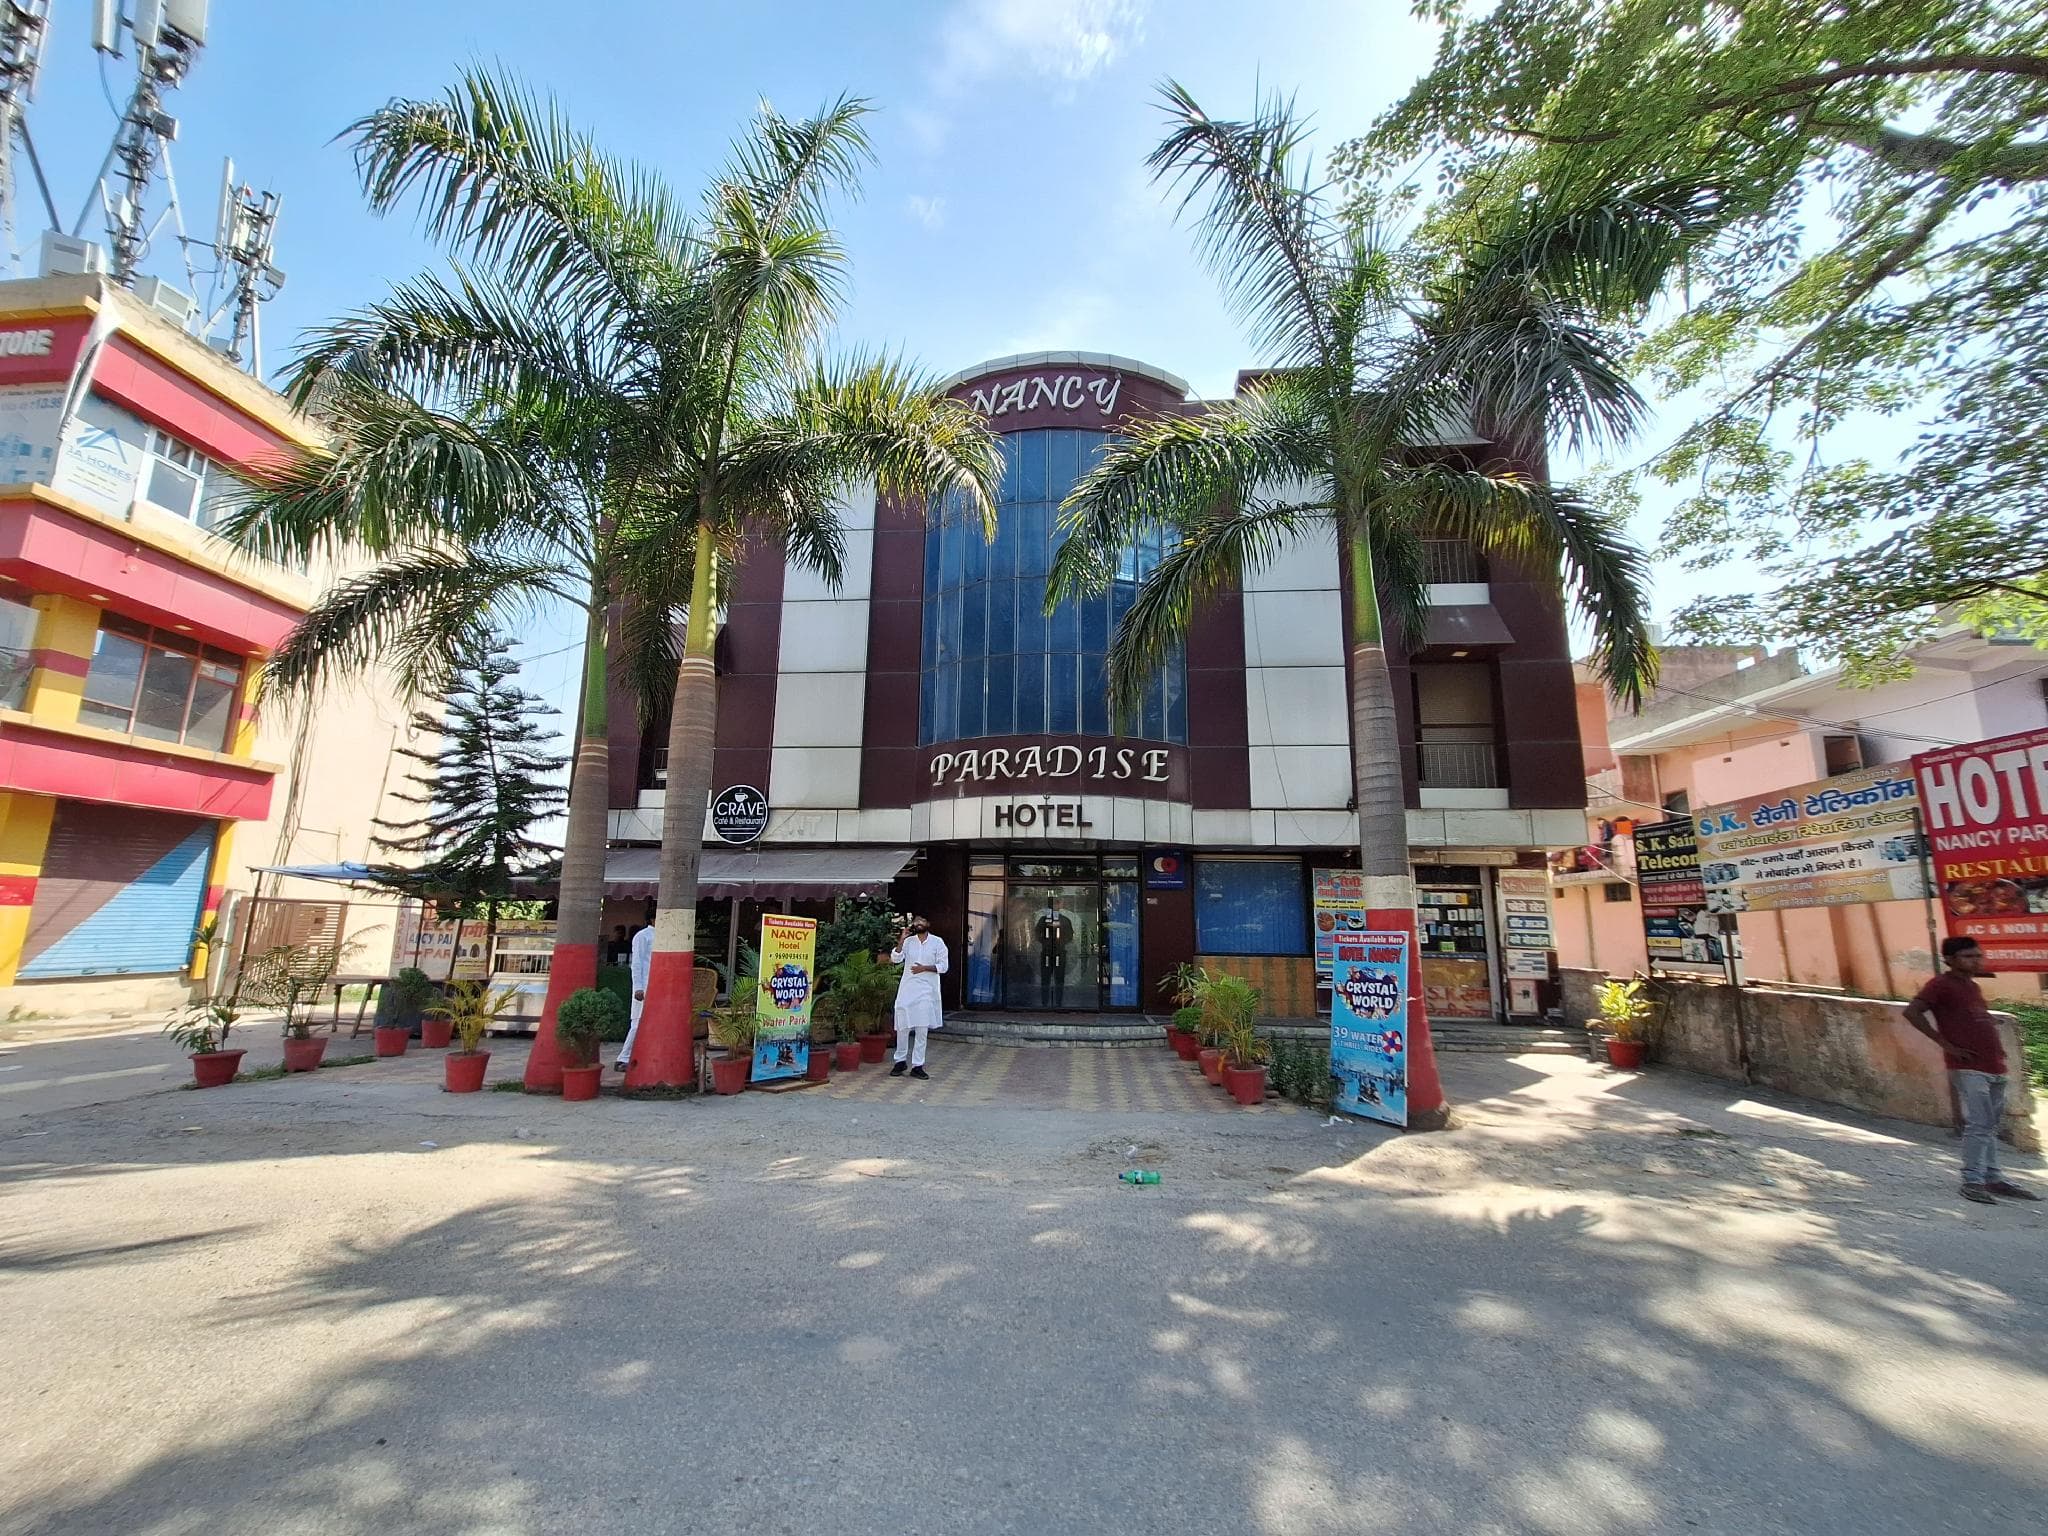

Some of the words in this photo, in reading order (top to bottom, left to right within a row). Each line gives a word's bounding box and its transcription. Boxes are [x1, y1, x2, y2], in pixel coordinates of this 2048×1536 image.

[971, 375, 1120, 416] NANCY
[931, 746, 1169, 786] PARADISE
[716, 801, 765, 816] CRAVE
[1700, 813, 1746, 836] S.K.
[1752, 799, 1798, 825] सैनी
[1803, 778, 1915, 815] टेलिकॉम
[735, 816, 765, 825] Restaurant
[995, 804, 1092, 827] HOTEL
[1935, 829, 2001, 851] NANCY
[1944, 856, 2048, 878] RESTAU
[771, 929, 809, 941] NANCY
[1966, 925, 1985, 934] AC
[2003, 923, 2037, 933] NON
[779, 941, 800, 950] Hotel
[1339, 935, 1358, 943] Tickets
[1359, 935, 1386, 943] Available
[1389, 935, 1403, 944] Here
[772, 976, 807, 989] CRYSTAL
[1346, 981, 1397, 996] CRYSTAL
[776, 988, 805, 999] WORLD
[1352, 995, 1393, 1009] WORLD
[788, 1014, 807, 1026] Park
[1333, 1026, 1348, 1039] 39
[1351, 1031, 1384, 1044] WATER
